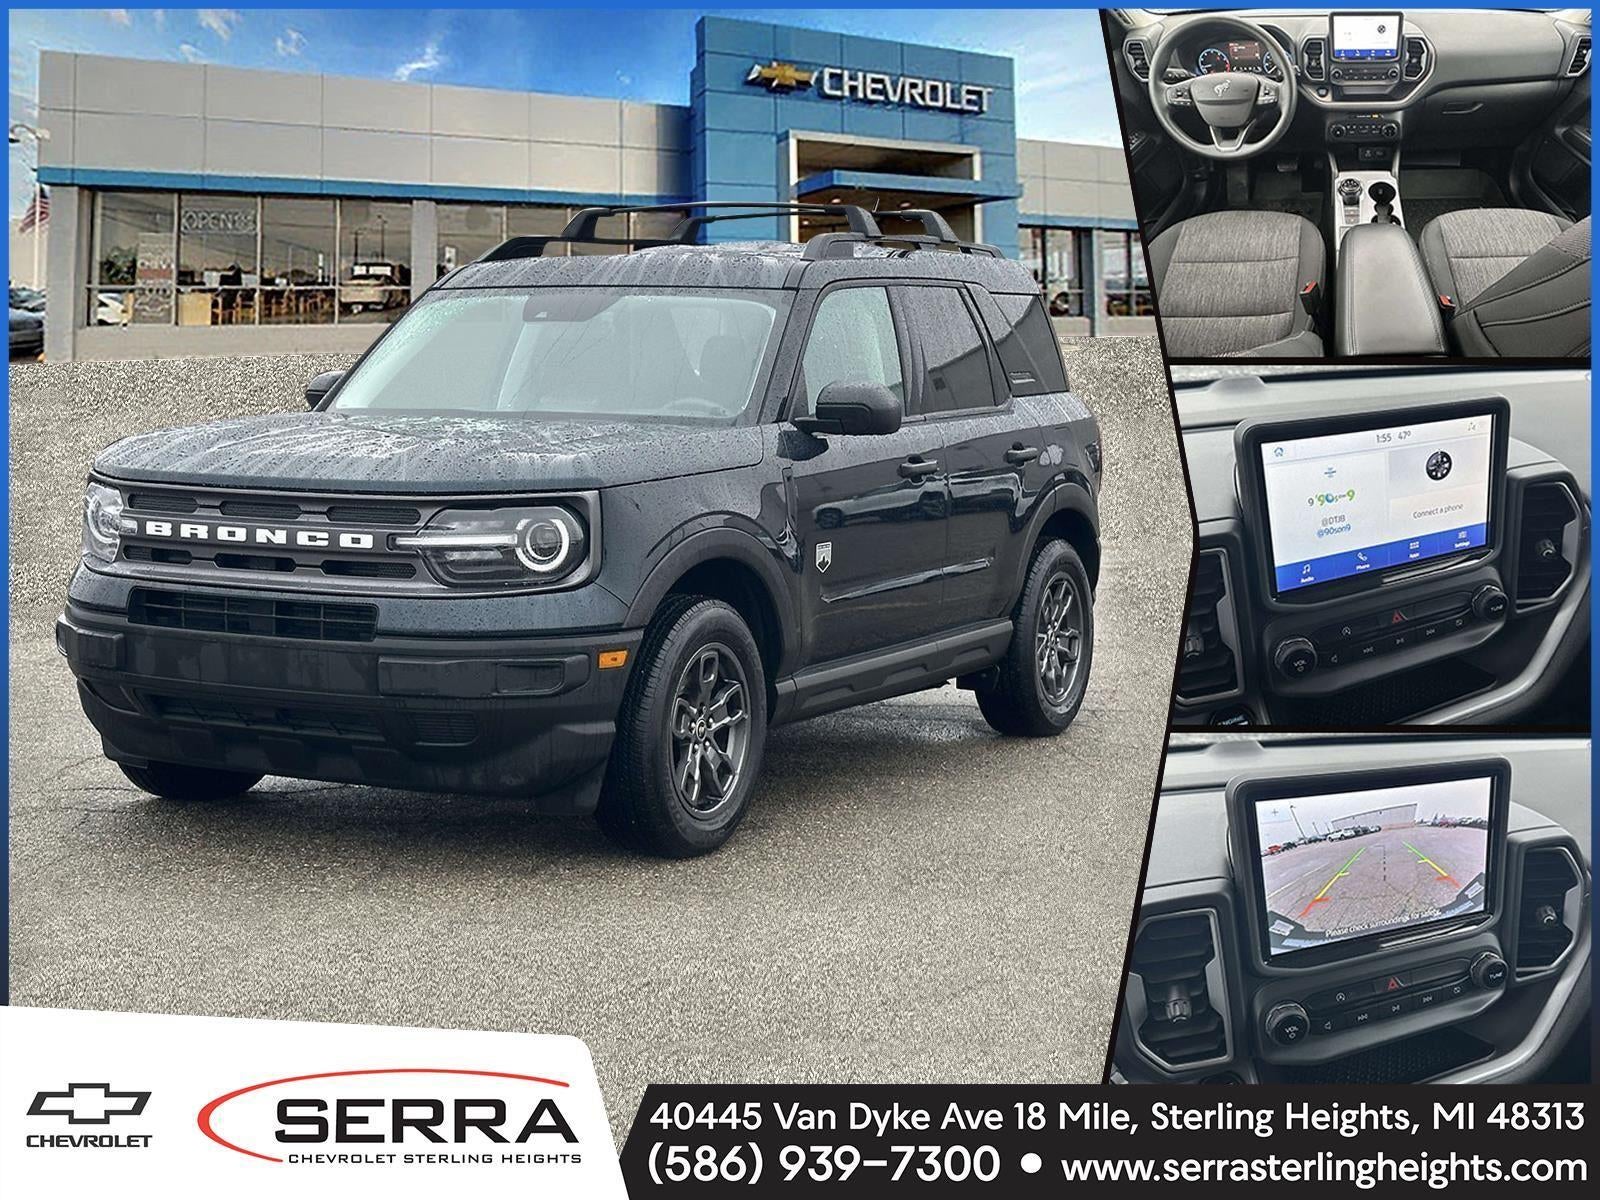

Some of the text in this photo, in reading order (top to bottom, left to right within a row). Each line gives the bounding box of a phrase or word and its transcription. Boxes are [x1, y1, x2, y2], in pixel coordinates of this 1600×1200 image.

[823, 67, 993, 112] CHEVROLET
[1376, 433, 1392, 443] 1:55
[1307, 497, 1315, 507] 9
[1412, 507, 1439, 520] Connect
[1444, 503, 1464, 515] phone
[145, 521, 374, 549] BRONCO
[1325, 925, 1349, 938] Please
[1349, 921, 1370, 933] check
